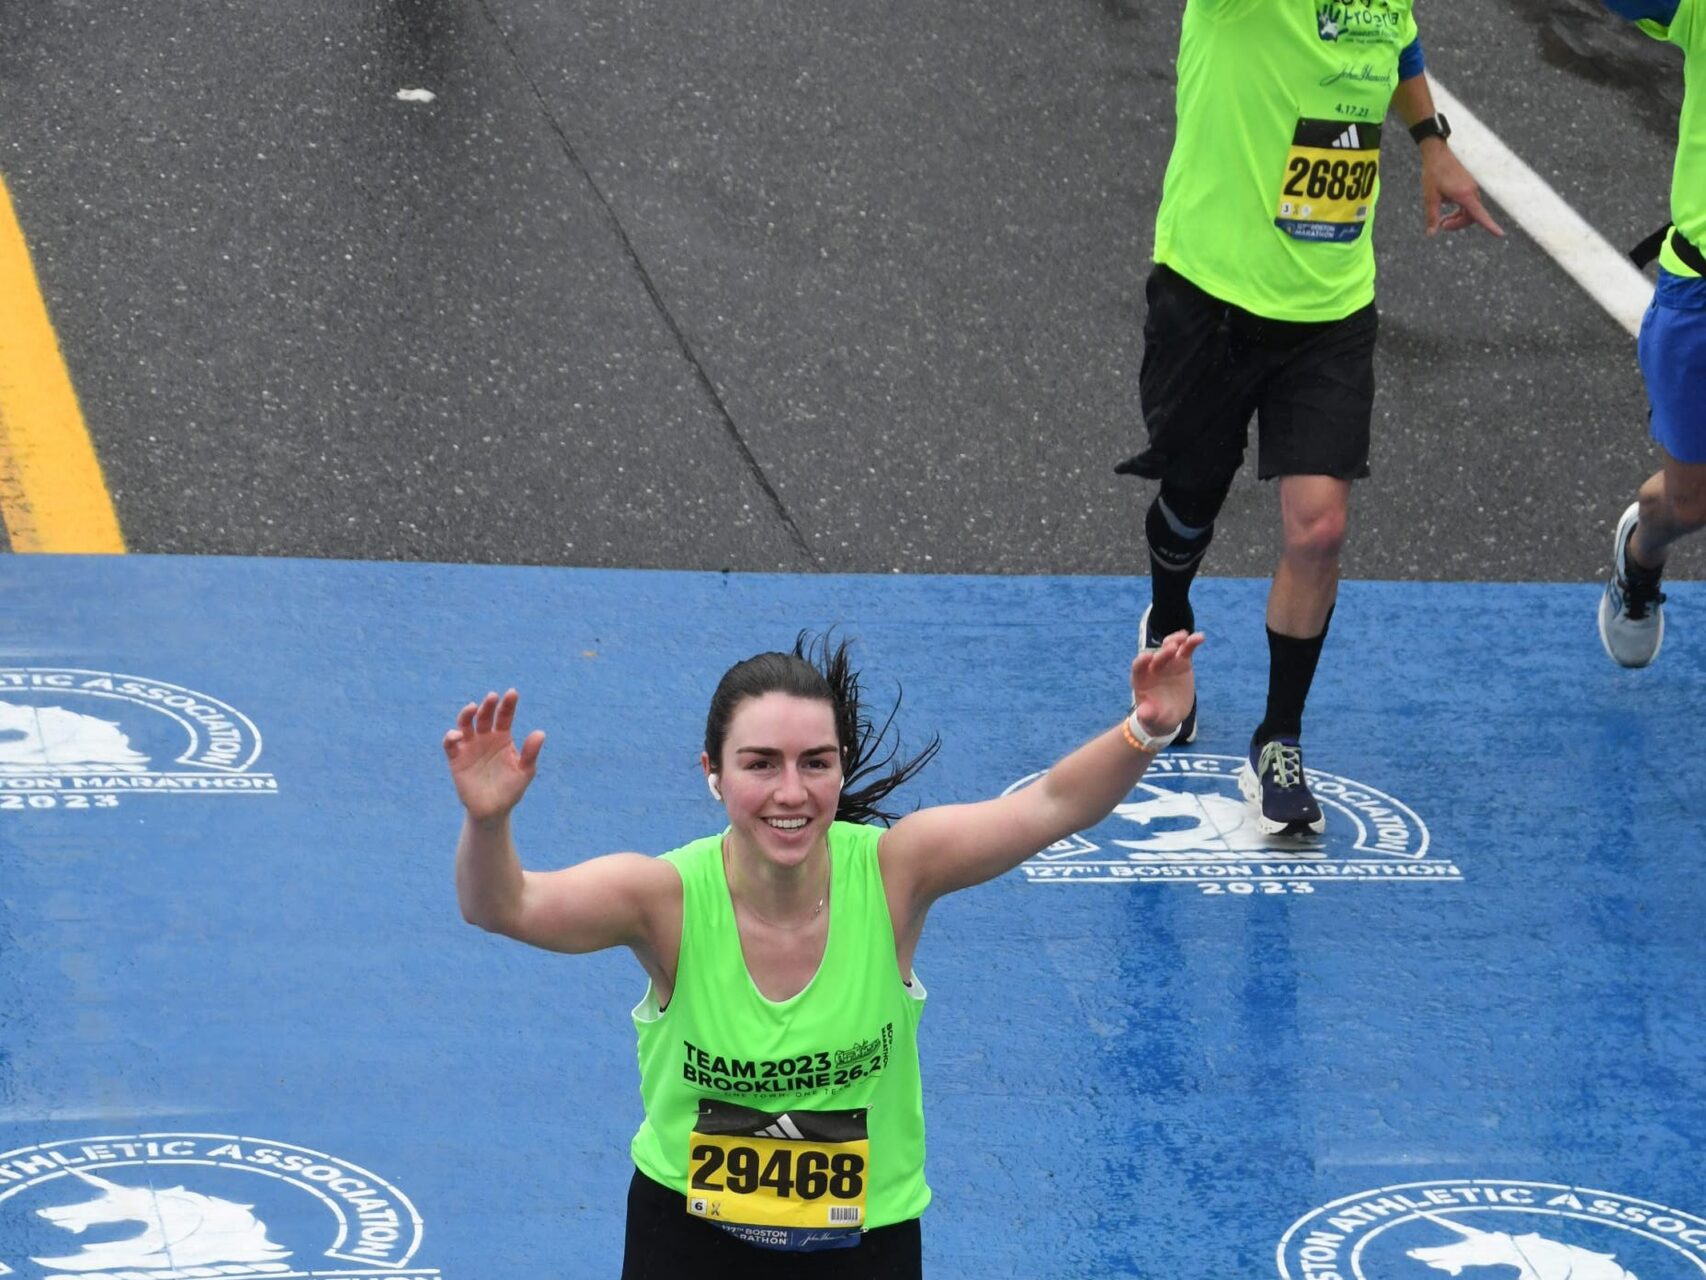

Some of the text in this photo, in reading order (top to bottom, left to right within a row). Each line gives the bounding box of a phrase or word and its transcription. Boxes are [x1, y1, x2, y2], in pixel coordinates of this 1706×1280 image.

[1283, 156, 1377, 201] 26830
[82, 677, 242, 765] ASSOCIATION
[73, 776, 279, 789] MARATHON
[0, 794, 120, 809] 2023
[1109, 864, 1253, 877] BOSTON
[1260, 863, 1462, 876] MARATHON
[1197, 881, 1315, 894] 2023
[683, 1040, 832, 1079] TEAM 2023
[683, 1055, 881, 1093] BROOKLINE 26.2
[691, 1144, 865, 1201] 29468
[206, 1143, 399, 1257] ASSOCIATION
[694, 1201, 703, 1212] 6
[1327, 1187, 1535, 1234] ATHLETIC
[733, 1233, 788, 1246] RATHON
[745, 1227, 788, 1238] BOSTON
